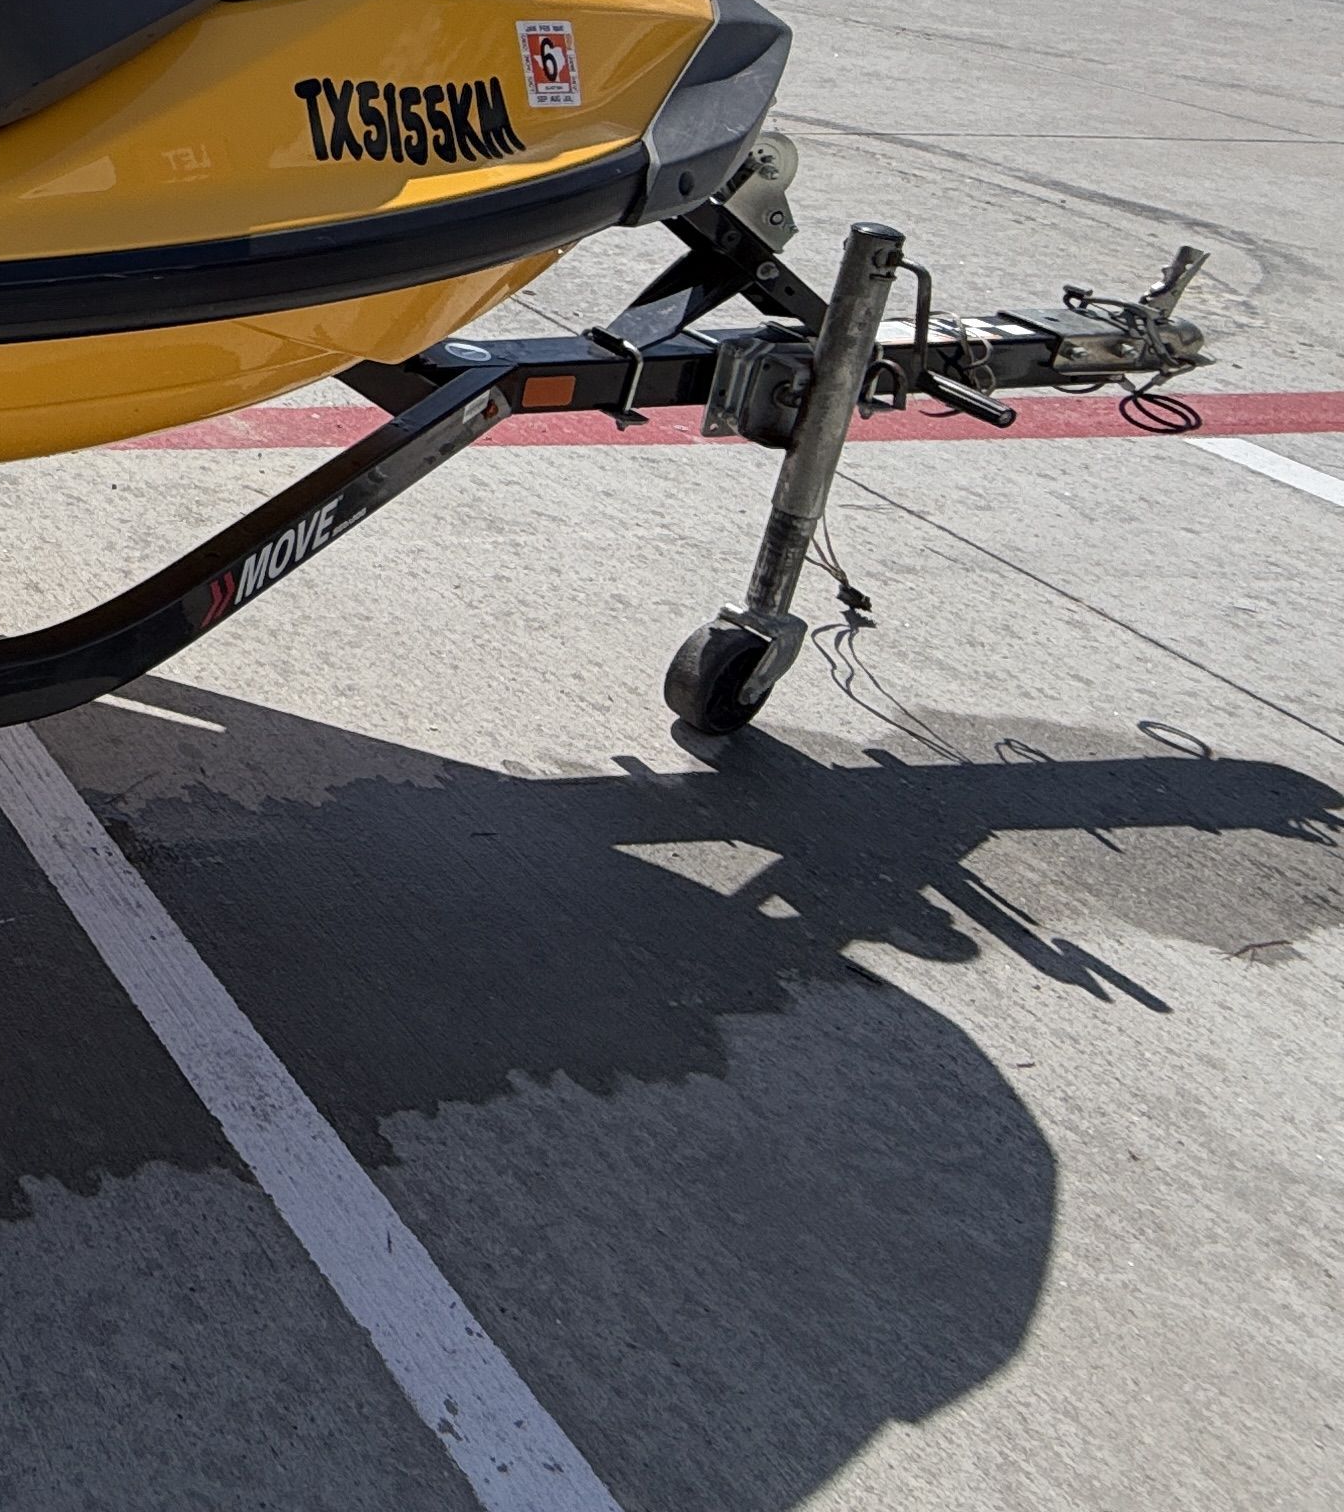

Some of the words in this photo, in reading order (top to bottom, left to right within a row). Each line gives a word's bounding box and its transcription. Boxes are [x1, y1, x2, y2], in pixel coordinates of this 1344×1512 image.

[540, 37, 558, 82] 6
[294, 76, 526, 166] TX5155KM
[234, 498, 339, 605] MOVE
